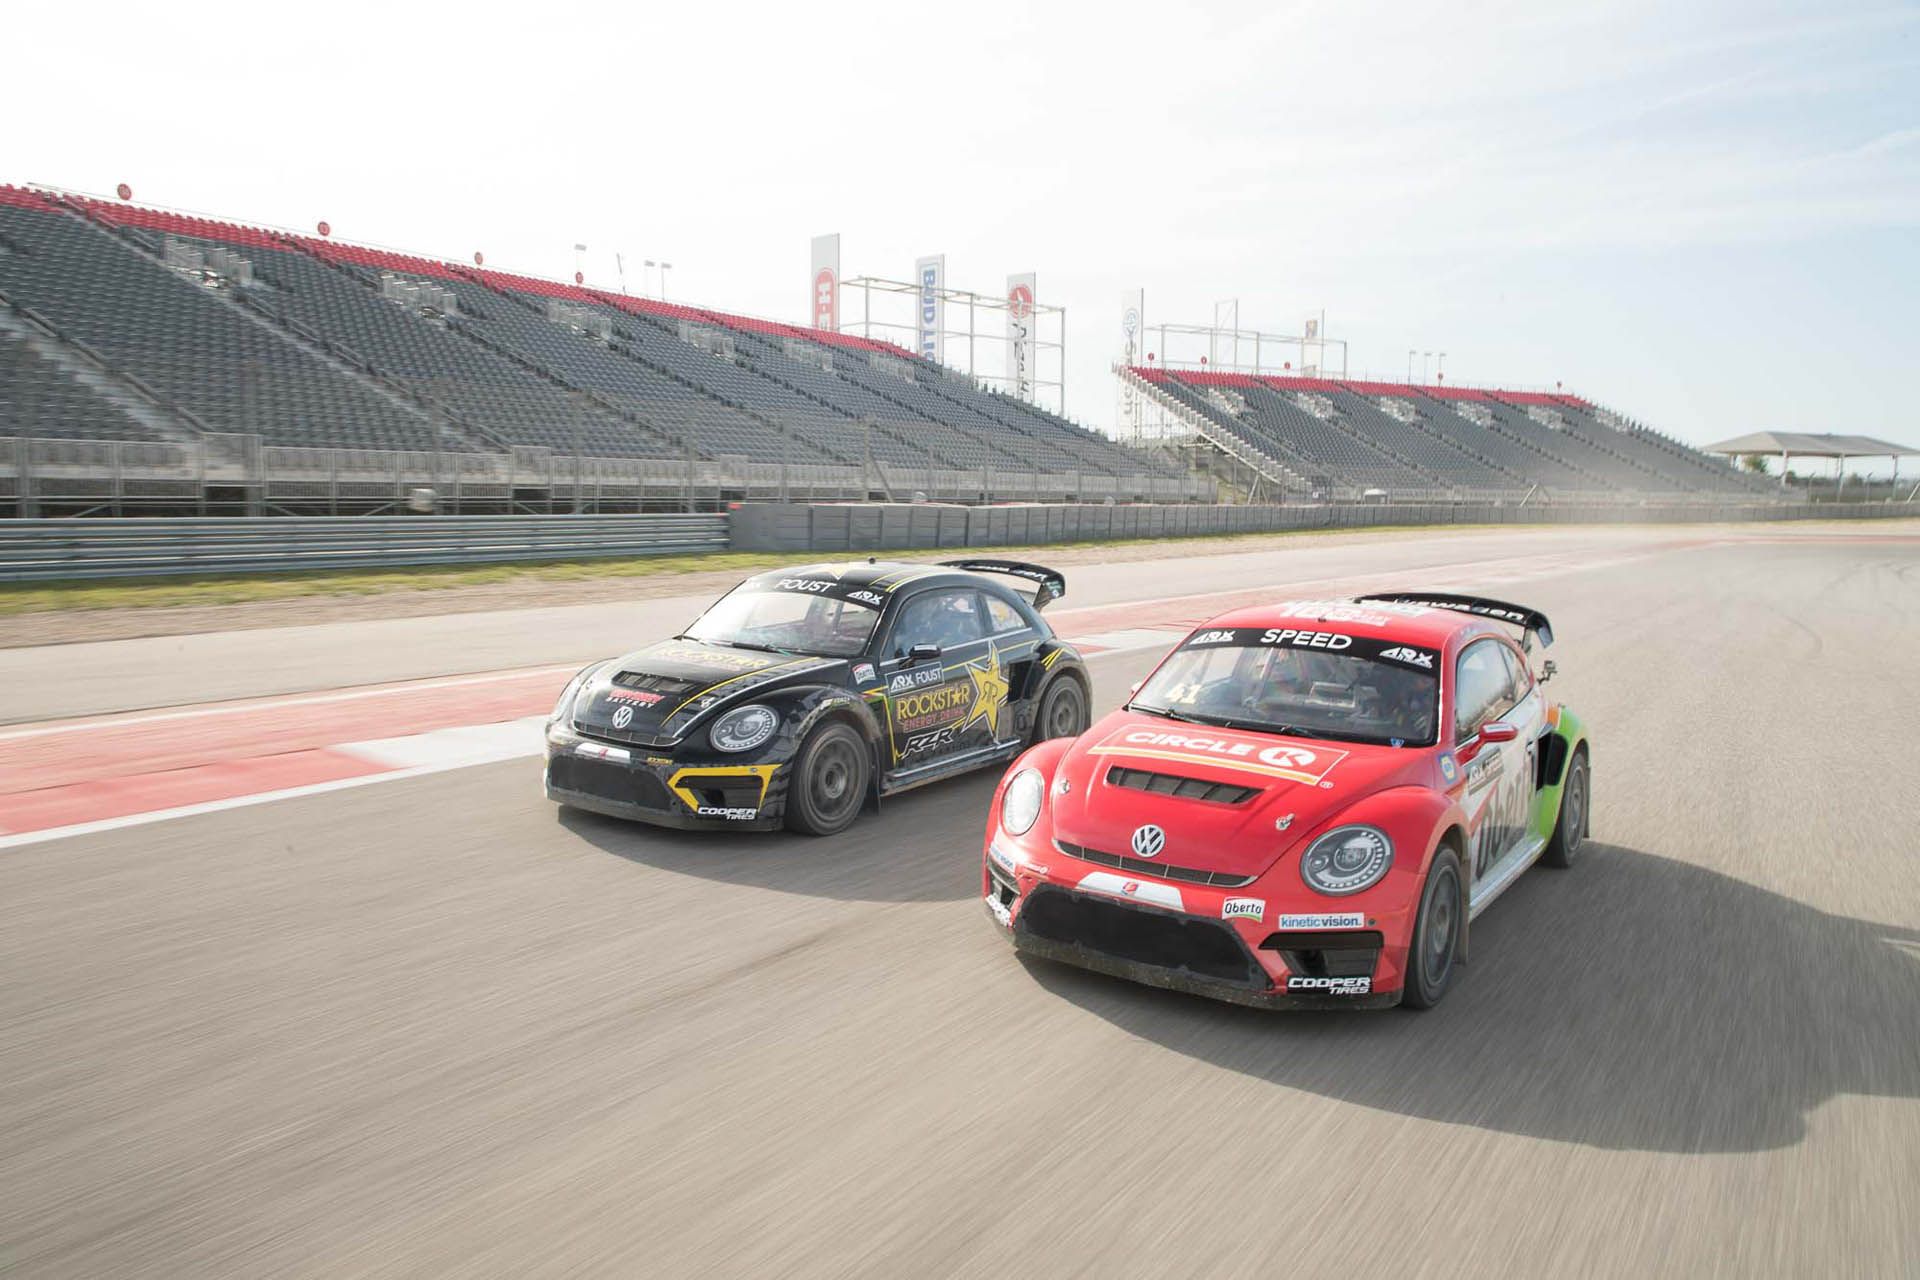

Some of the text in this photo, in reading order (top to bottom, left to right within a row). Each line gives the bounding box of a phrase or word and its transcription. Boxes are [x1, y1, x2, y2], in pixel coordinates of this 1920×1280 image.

[923, 269, 935, 324] BUD
[775, 579, 838, 592] FOUST
[1261, 629, 1352, 650] SPEED
[915, 667, 942, 685] FOUST
[1125, 732, 1317, 767] CIRCLE K
[698, 807, 757, 816] COOPER
[1224, 902, 1262, 914] Oberto
[1288, 976, 1371, 988] COOPER
[1329, 986, 1370, 995] TIRES
